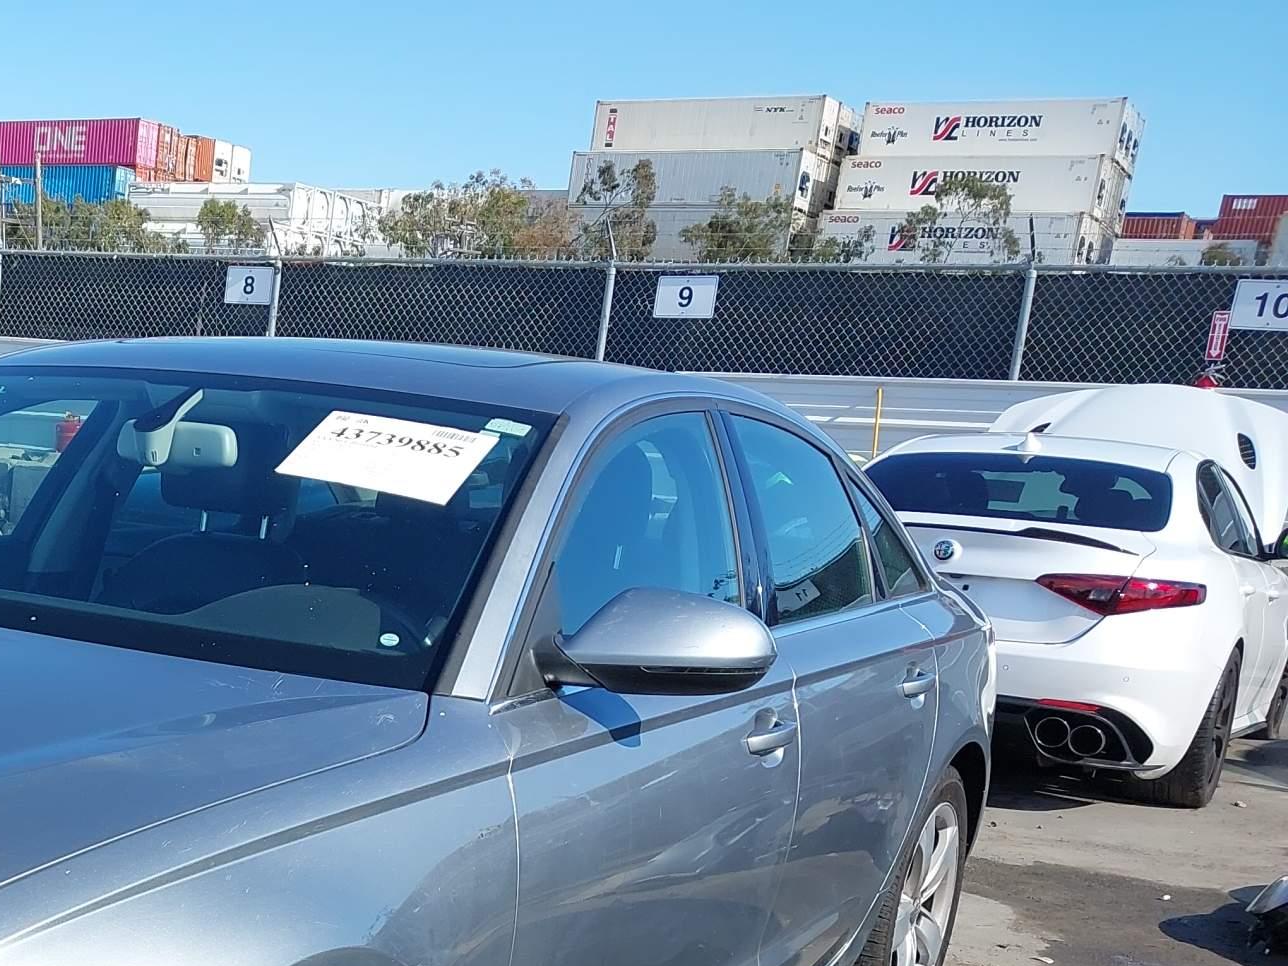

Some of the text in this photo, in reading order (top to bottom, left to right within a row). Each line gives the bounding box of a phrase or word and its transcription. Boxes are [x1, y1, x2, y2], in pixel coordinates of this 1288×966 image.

[874, 107, 905, 115] seaco
[964, 115, 1043, 128] HORIZON
[34, 126, 86, 151] ONE
[961, 129, 1029, 137] LINES
[851, 161, 882, 169] seaco
[942, 170, 1021, 183] HORIZON
[828, 215, 859, 223] seaco
[919, 226, 1000, 239] HORIZON
[243, 276, 255, 295] 8
[678, 286, 693, 308] 9
[331, 427, 465, 458] 43739885
